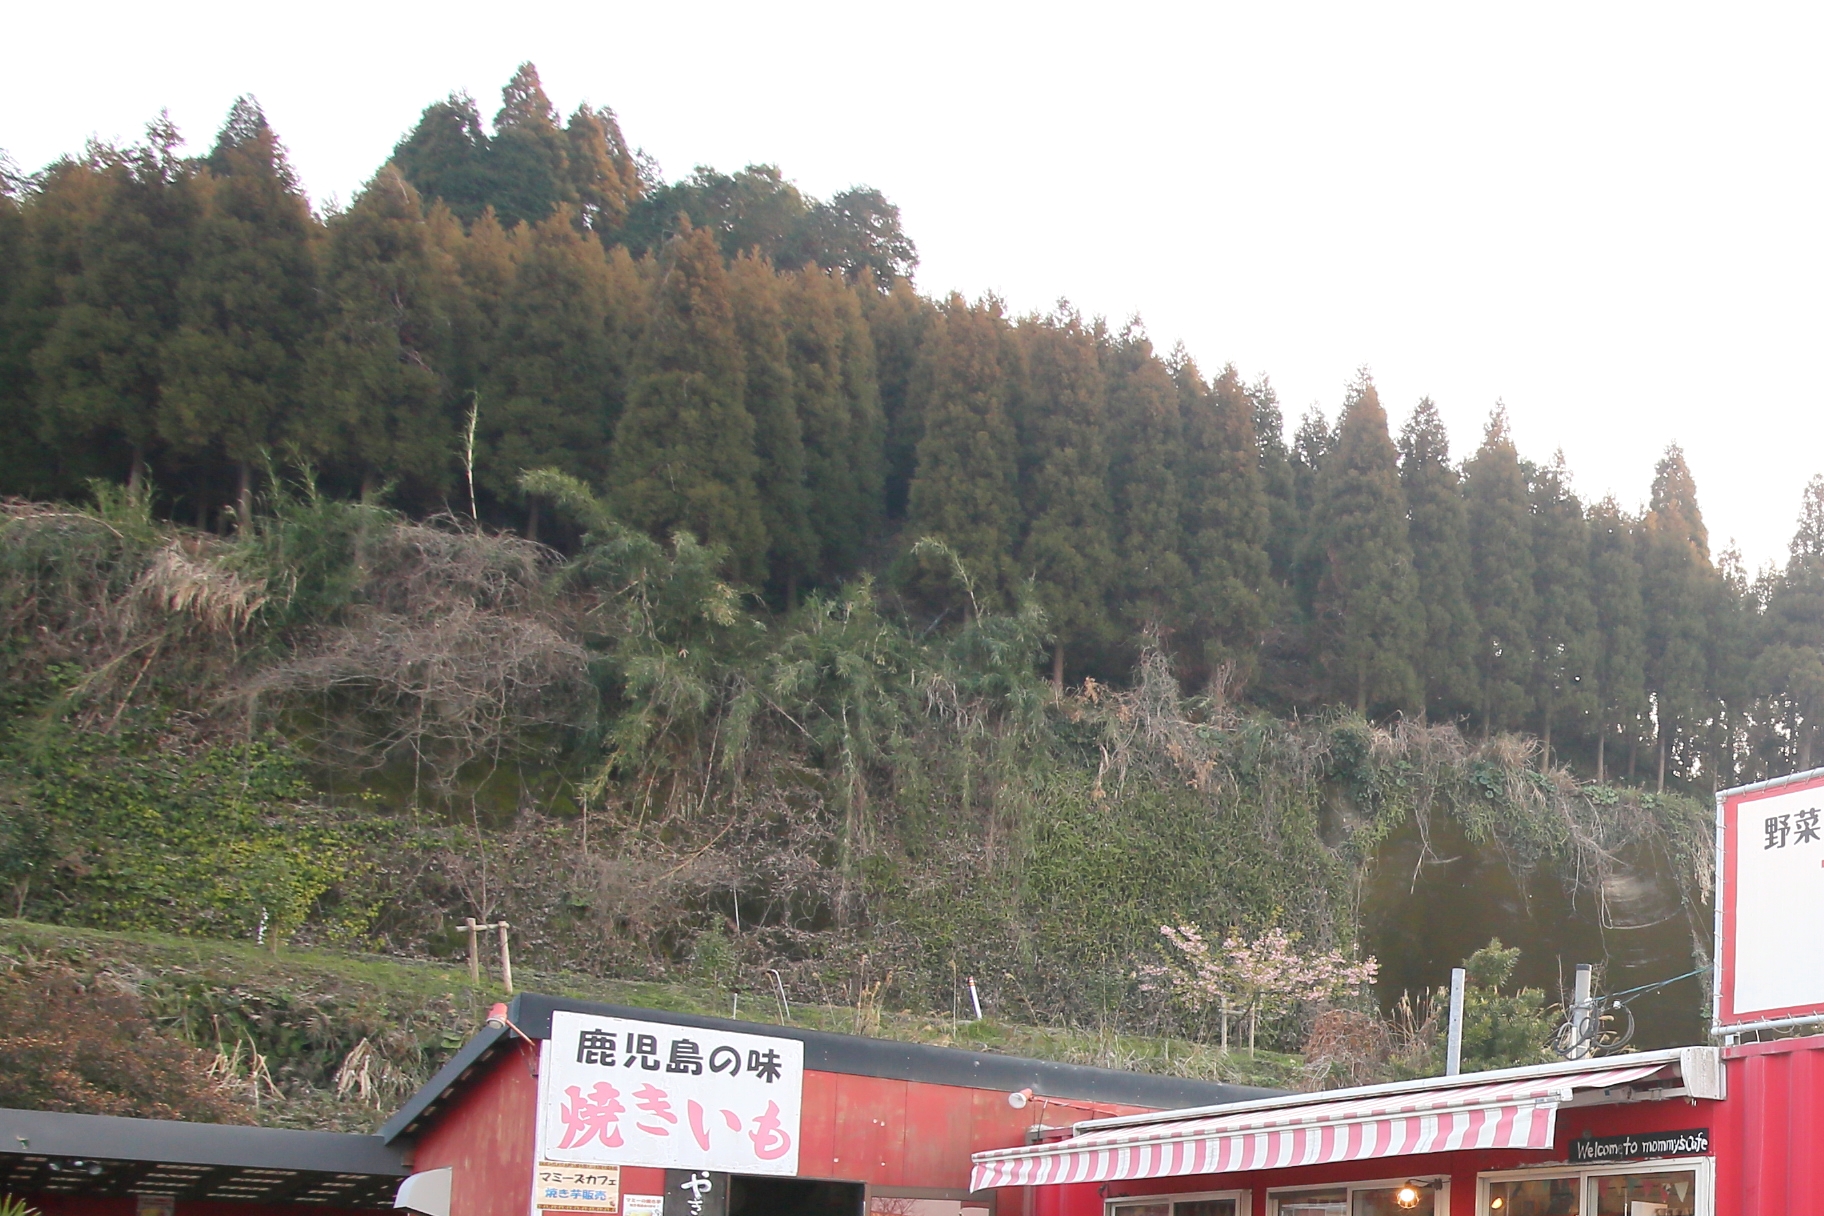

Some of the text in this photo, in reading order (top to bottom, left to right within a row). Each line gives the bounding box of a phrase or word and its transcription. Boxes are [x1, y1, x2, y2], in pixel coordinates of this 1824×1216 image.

[576, 1028, 782, 1084] 鹿児島の味
[556, 1081, 792, 1161] 焼きいも
[1622, 1136, 1638, 1156] to
[538, 1172, 617, 1187] マミーズカフェ
[544, 1187, 607, 1201] 焼き芋販売
